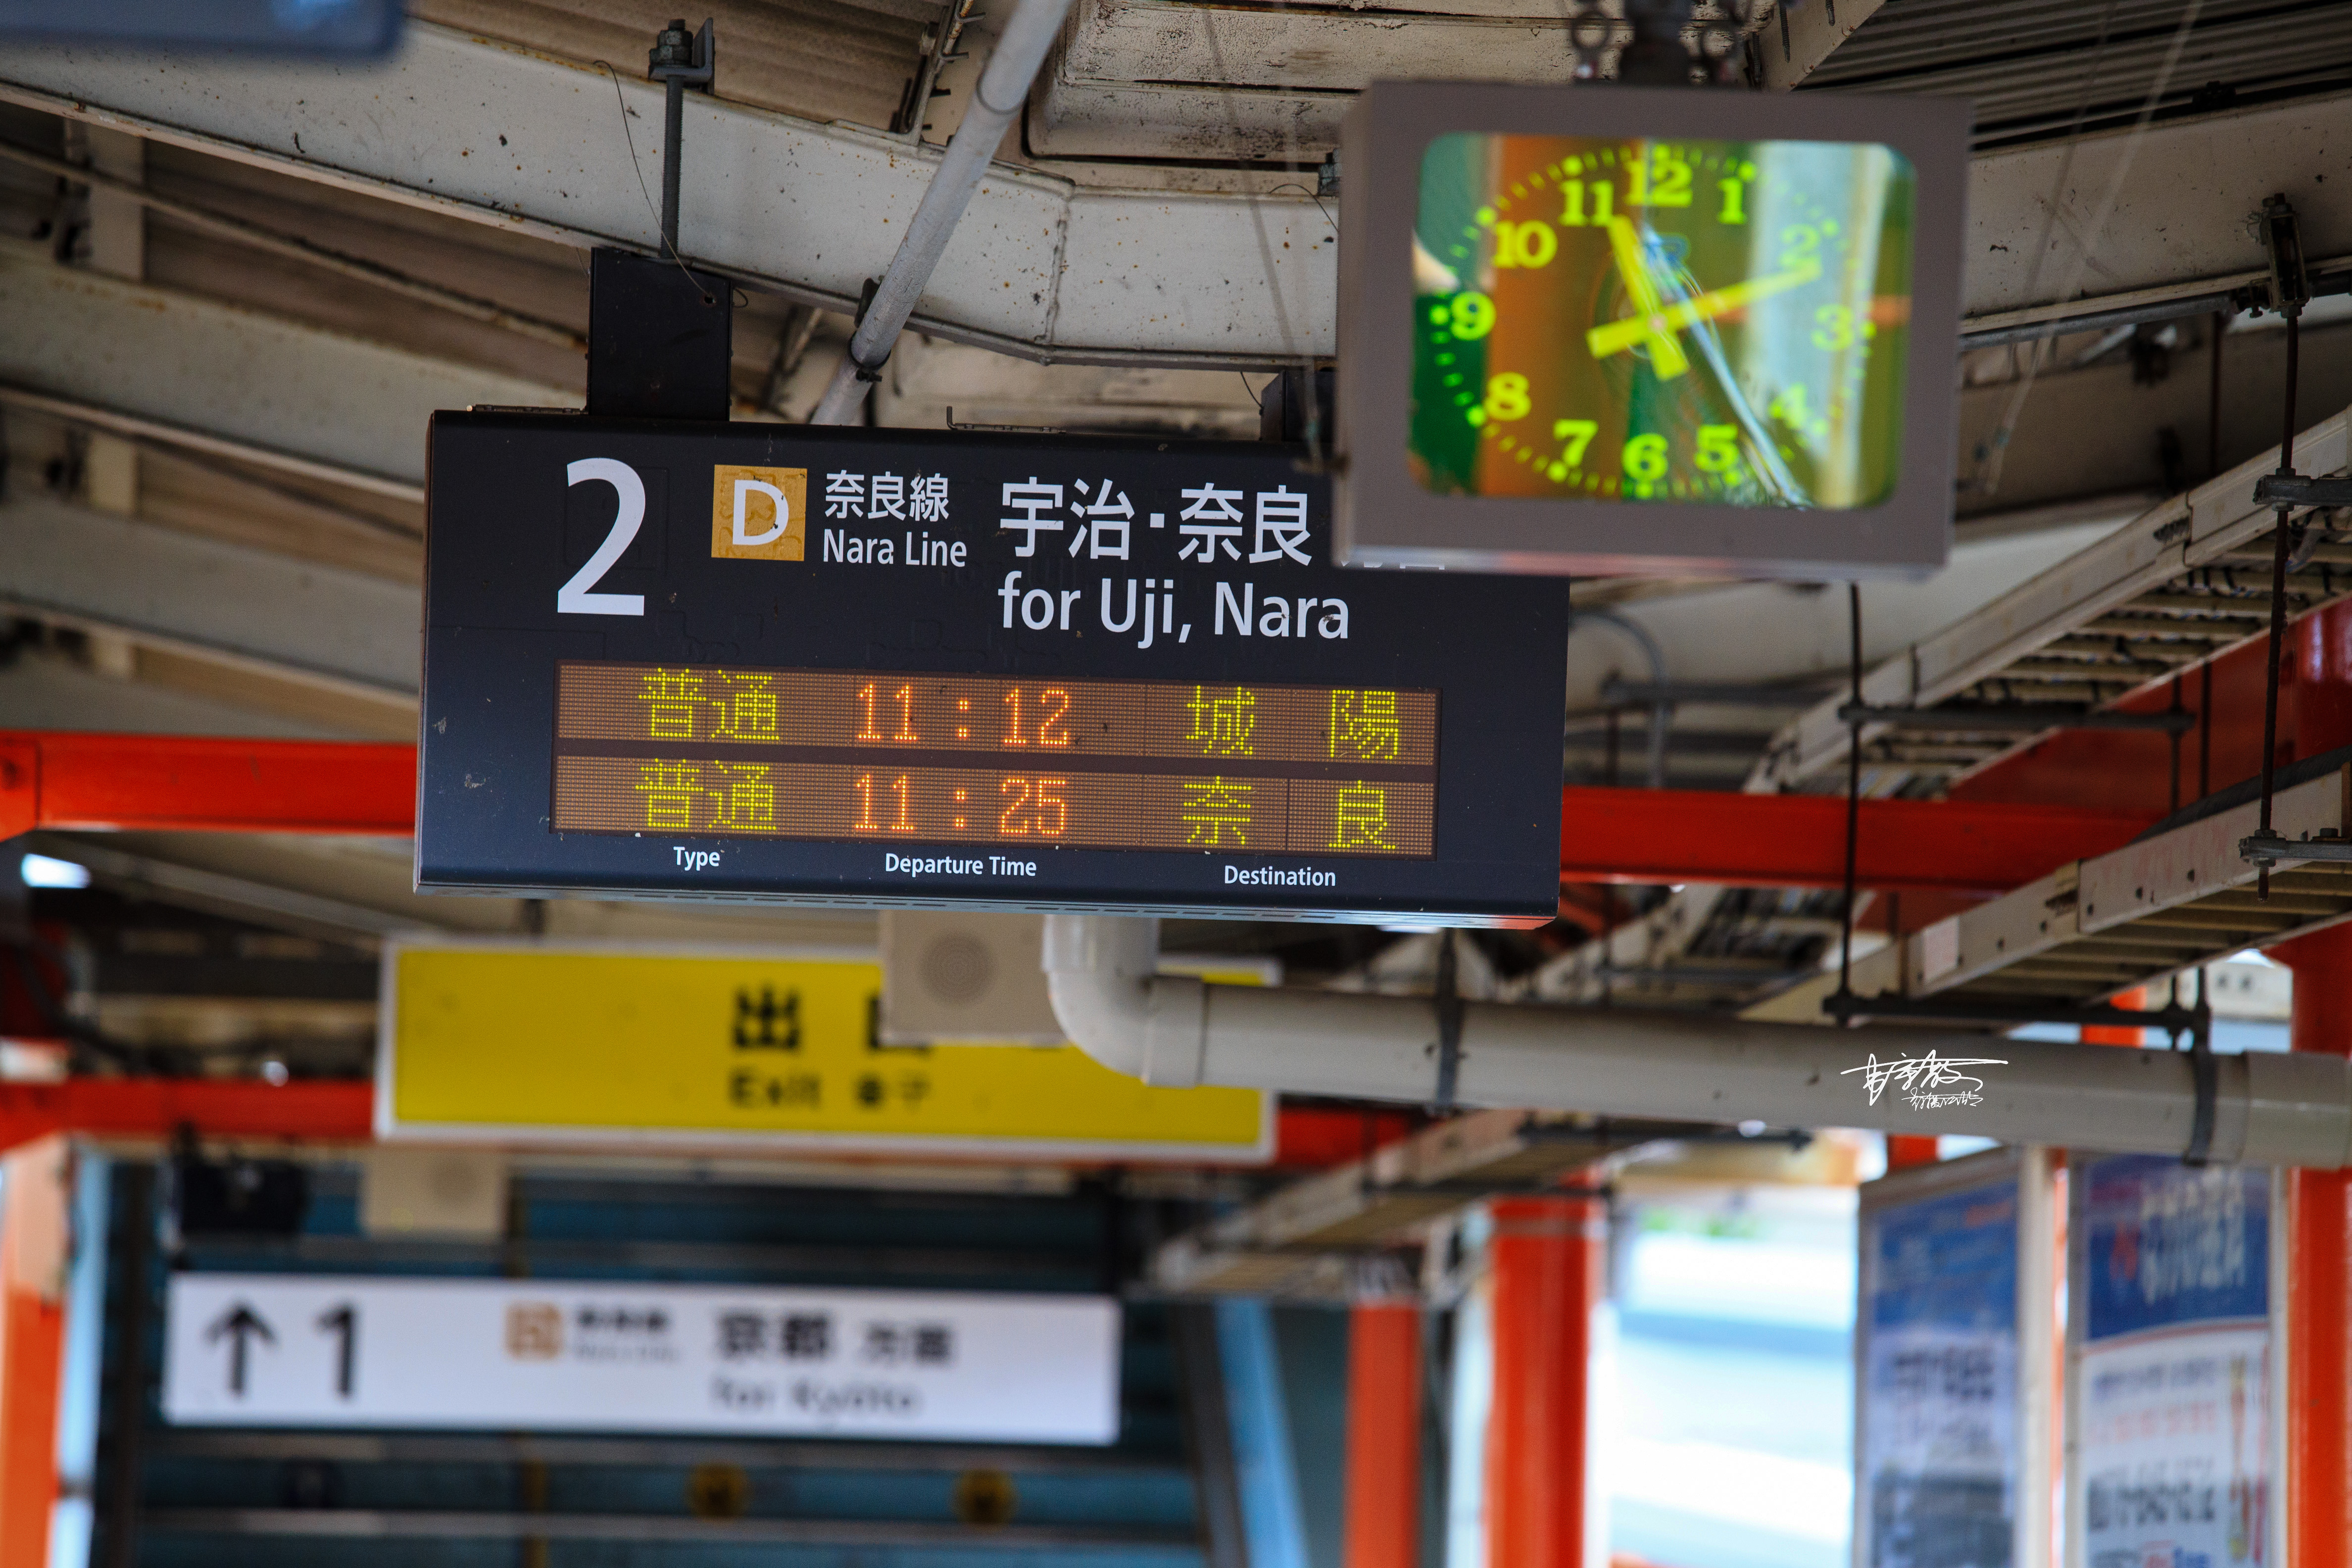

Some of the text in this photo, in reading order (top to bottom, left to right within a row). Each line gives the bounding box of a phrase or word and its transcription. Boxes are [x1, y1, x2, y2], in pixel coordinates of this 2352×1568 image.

[1561, 179, 1614, 227] 11
[1625, 160, 1692, 206] 12
[1718, 177, 1748, 224] 1
[1491, 221, 1556, 269] 10
[1780, 223, 1821, 270] 2
[1449, 291, 1496, 341] 9
[1811, 304, 1854, 351] 3
[1484, 373, 1531, 421] 8
[1768, 382, 1813, 429] 4
[1553, 420, 1597, 467] 7
[1622, 433, 1668, 482] 6
[1694, 424, 1739, 472] 5
[733, 479, 788, 546] D
[825, 470, 949, 522] 奈良線
[557, 457, 645, 616] 2
[824, 529, 967, 567] Nara Line
[998, 571, 1349, 649] for Uji, Nara
[638, 667, 780, 740] 普通
[635, 758, 777, 831] 普通
[673, 846, 725, 871] Type
[885, 853, 1036, 878] Departure Time
[1225, 865, 1335, 886] Destination
[318, 1302, 357, 1400] 1
